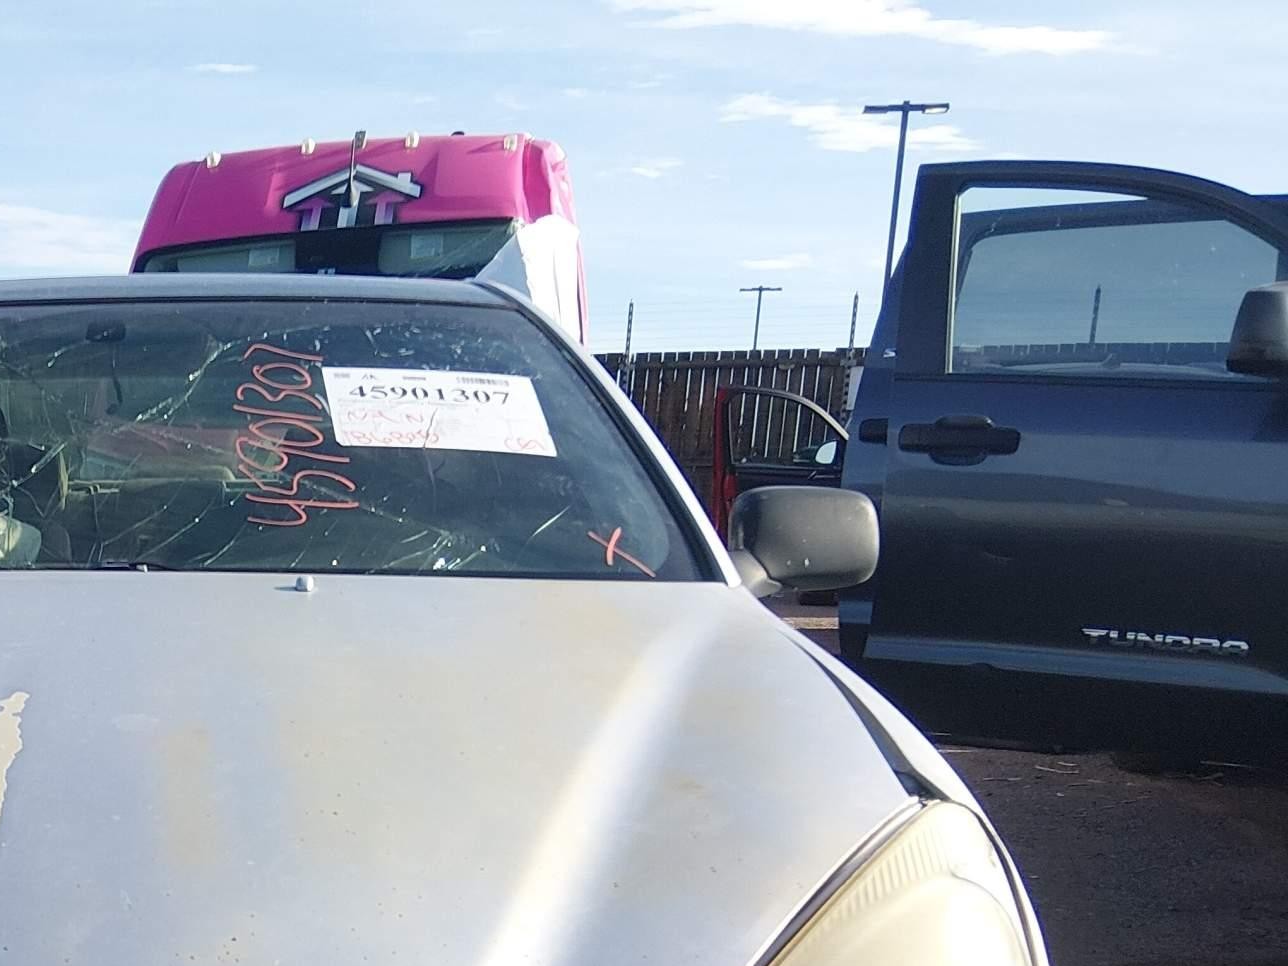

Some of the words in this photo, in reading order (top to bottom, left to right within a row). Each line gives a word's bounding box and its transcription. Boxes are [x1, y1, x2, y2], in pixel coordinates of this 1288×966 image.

[348, 384, 511, 406] 45901307
[233, 343, 361, 527] 45901307
[1080, 628, 1251, 656] TUNDRA
